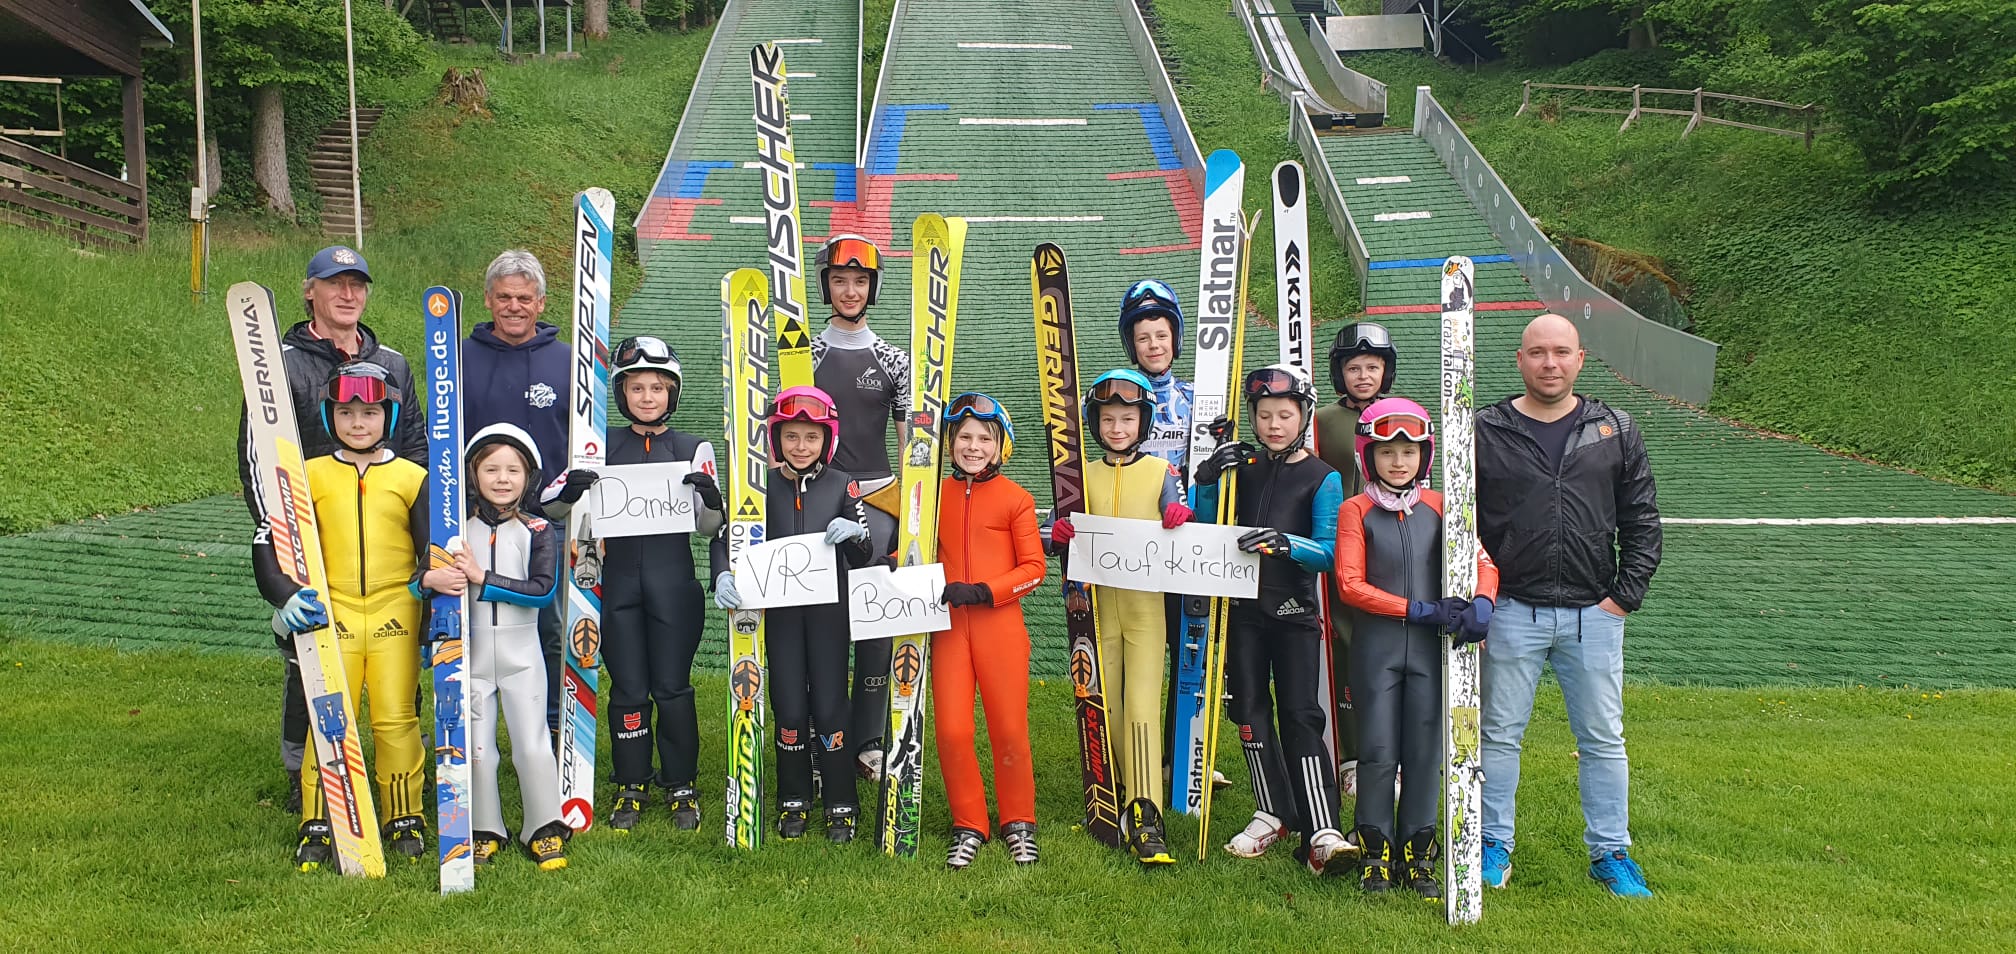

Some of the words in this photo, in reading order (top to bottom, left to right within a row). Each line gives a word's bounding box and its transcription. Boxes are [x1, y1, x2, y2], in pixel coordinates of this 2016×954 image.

[752, 43, 802, 320] FISCHER
[1198, 218, 1237, 351] Slatnar
[577, 214, 598, 427] SPORTEN
[778, 349, 810, 357] FISCHER
[244, 303, 279, 425] GERMINA
[431, 331, 453, 440] fluege.de
[1040, 294, 1066, 467] GERMINA
[1442, 318, 1454, 398] crazyfalcon
[747, 298, 768, 496] FISCHER
[279, 476, 298, 531] JUMP
[437, 447, 458, 529] youngster
[593, 476, 693, 521] Danke
[293, 535, 308, 577] SXC
[746, 541, 828, 599] VR-
[851, 578, 949, 623] Bank
[1276, 606, 1305, 616] adidas
[373, 628, 409, 639] adidas
[562, 676, 578, 798] SPORTEN
[819, 730, 844, 749] VR
[1085, 706, 1099, 733] SX
[1091, 732, 1104, 783] JUMP
[1187, 737, 1205, 809] Slatnar
[727, 775, 736, 849] FISCHER
[783, 800, 803, 808] HOP
[832, 807, 852, 815] HOP
[885, 773, 899, 858] FISCHER
